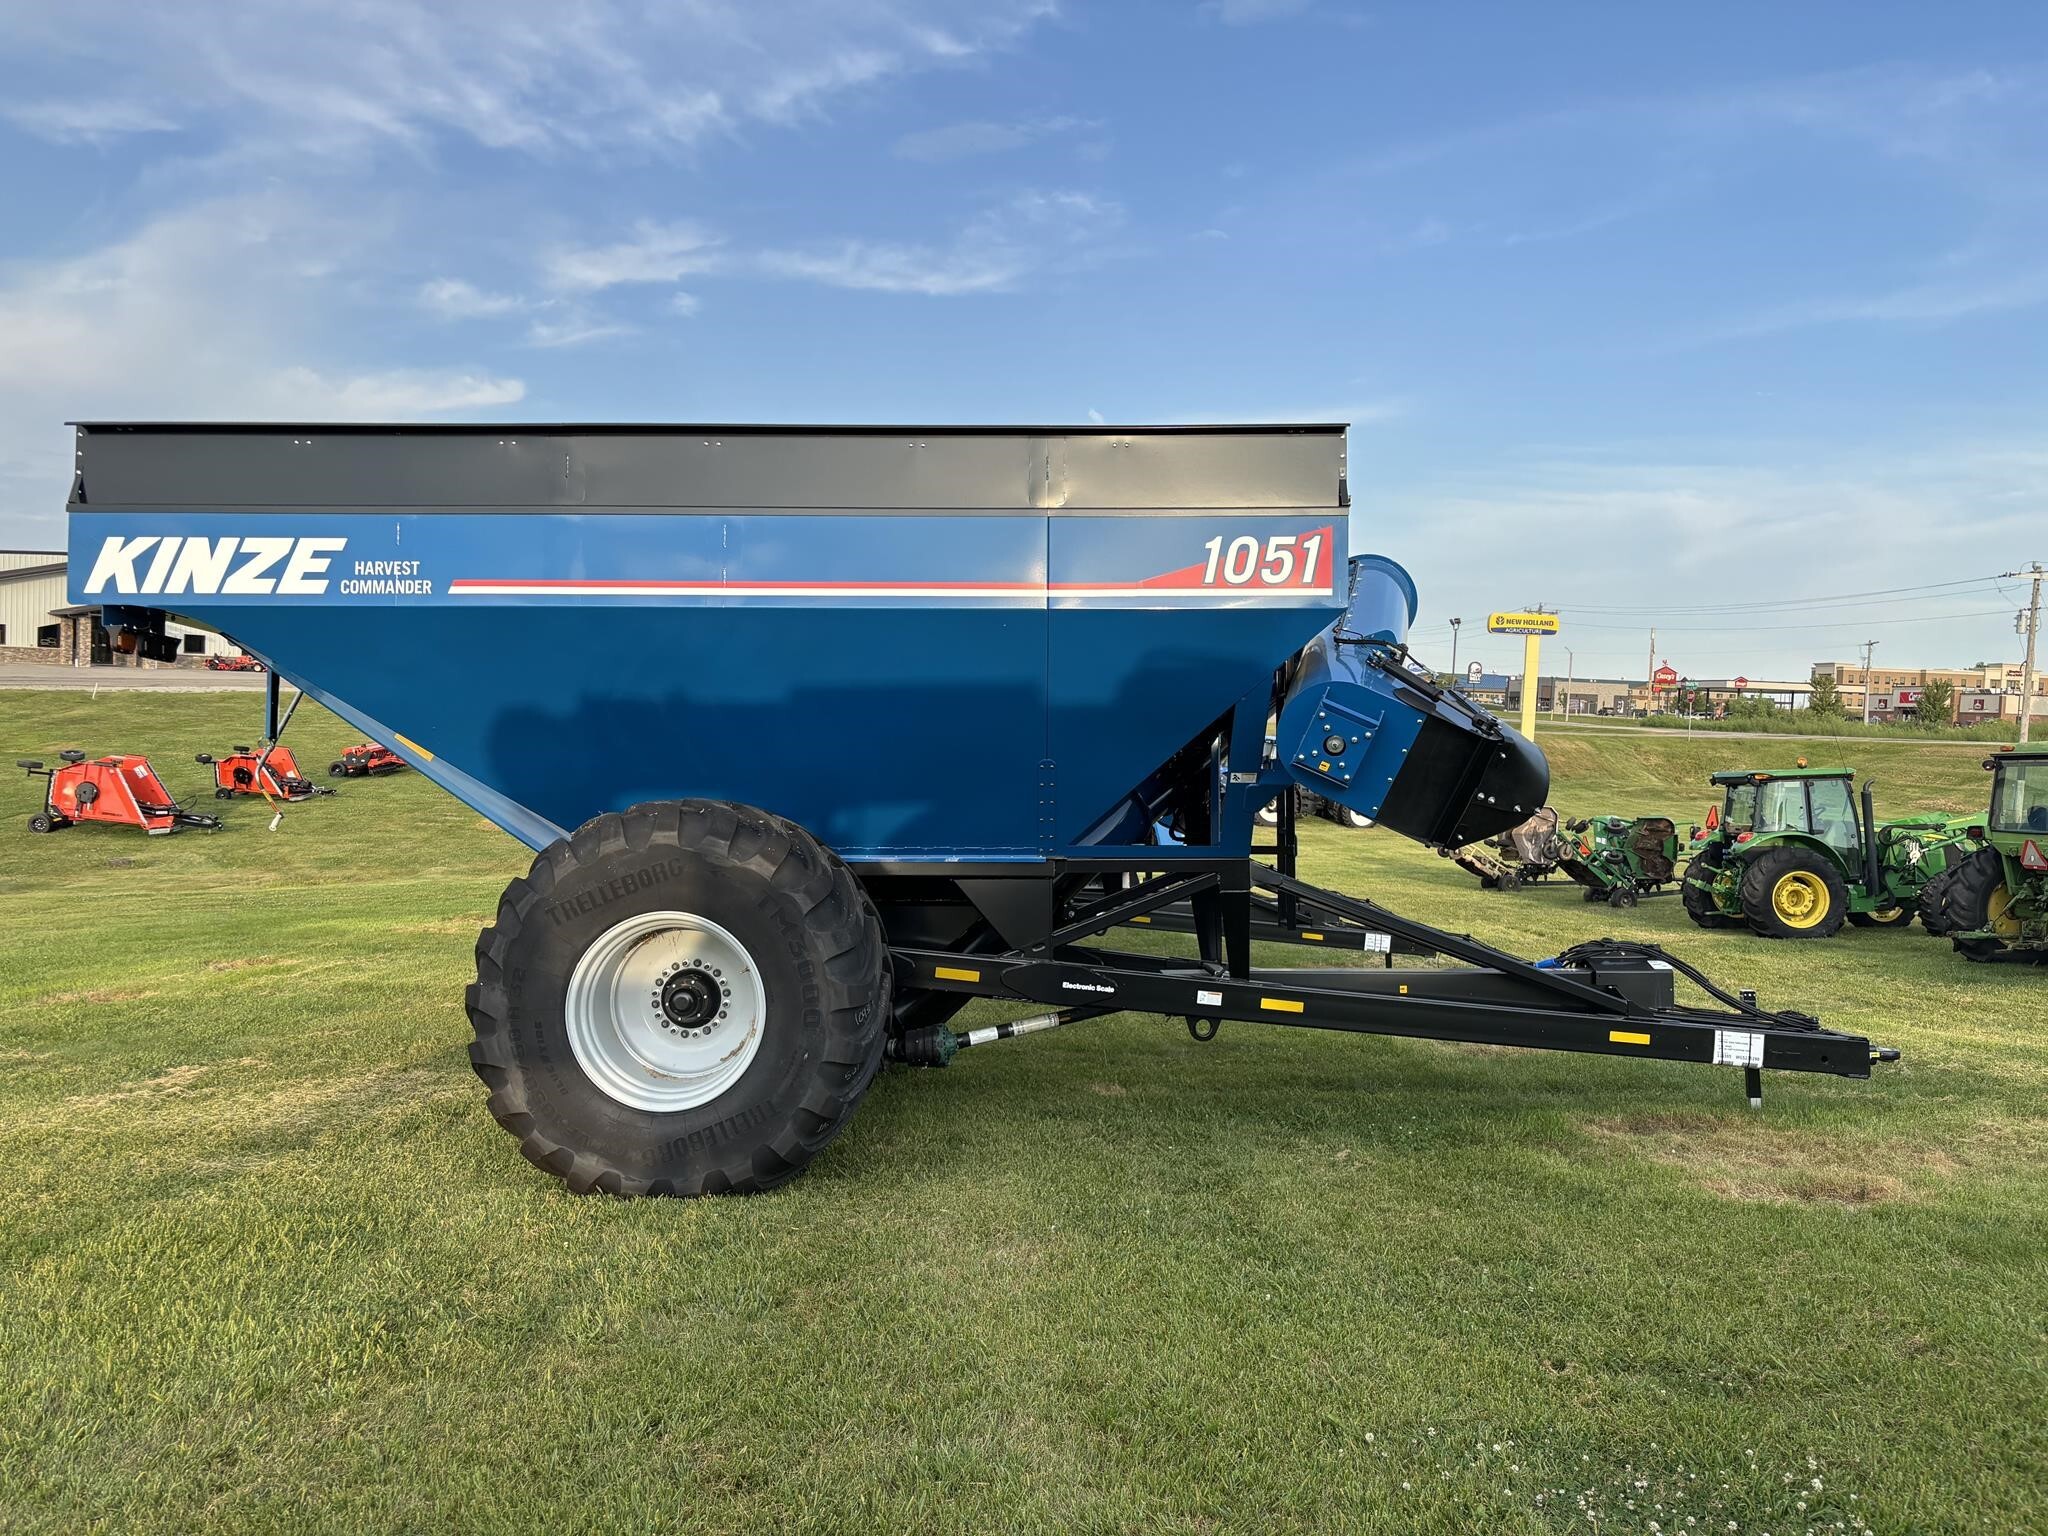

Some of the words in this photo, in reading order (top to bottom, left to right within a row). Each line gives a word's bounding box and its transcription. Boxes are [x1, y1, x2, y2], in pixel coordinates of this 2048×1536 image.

[83, 536, 348, 594] KINZE
[1204, 535, 1321, 584] 1051
[354, 561, 421, 576] HARVEST
[340, 579, 432, 595] COMMANDER
[1523, 619, 1554, 627] HOLLAND
[1656, 673, 1675, 681] Casey's
[545, 857, 684, 927] TRELLEBORG
[1062, 981, 1096, 991] Electronic
[1096, 984, 1115, 993] Scale
